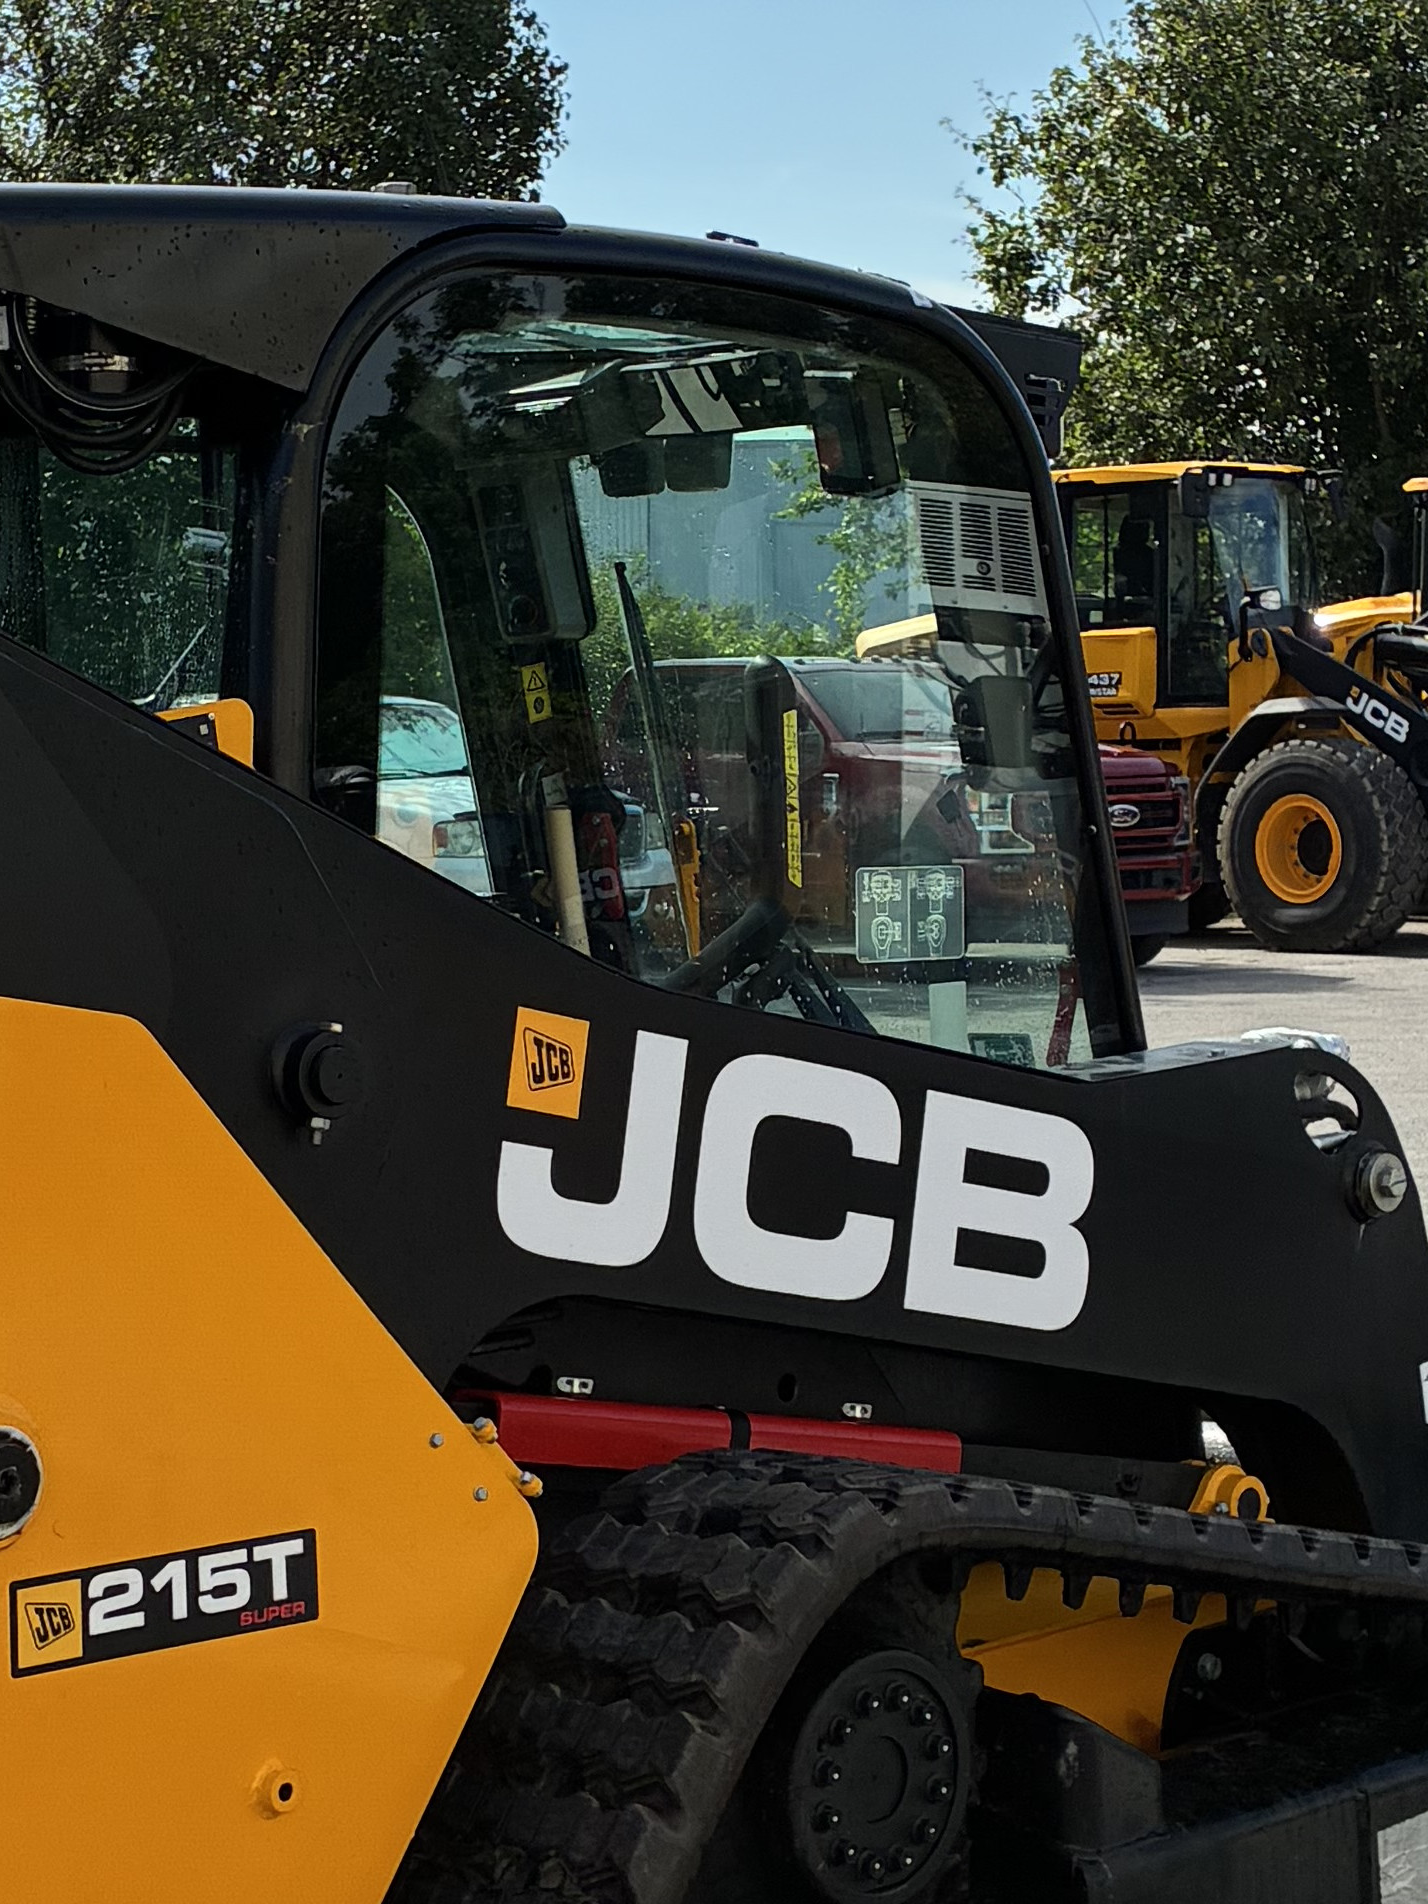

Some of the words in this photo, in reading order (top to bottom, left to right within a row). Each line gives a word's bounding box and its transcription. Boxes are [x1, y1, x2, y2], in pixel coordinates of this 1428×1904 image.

[1088, 673, 1120, 685] 437
[1346, 692, 1409, 743] JCB
[531, 1036, 571, 1084] JCB
[497, 1029, 1094, 1331] JCB
[34, 1606, 72, 1643] JCB
[88, 1538, 304, 1636] 215T
[239, 1601, 305, 1627] SUPER
